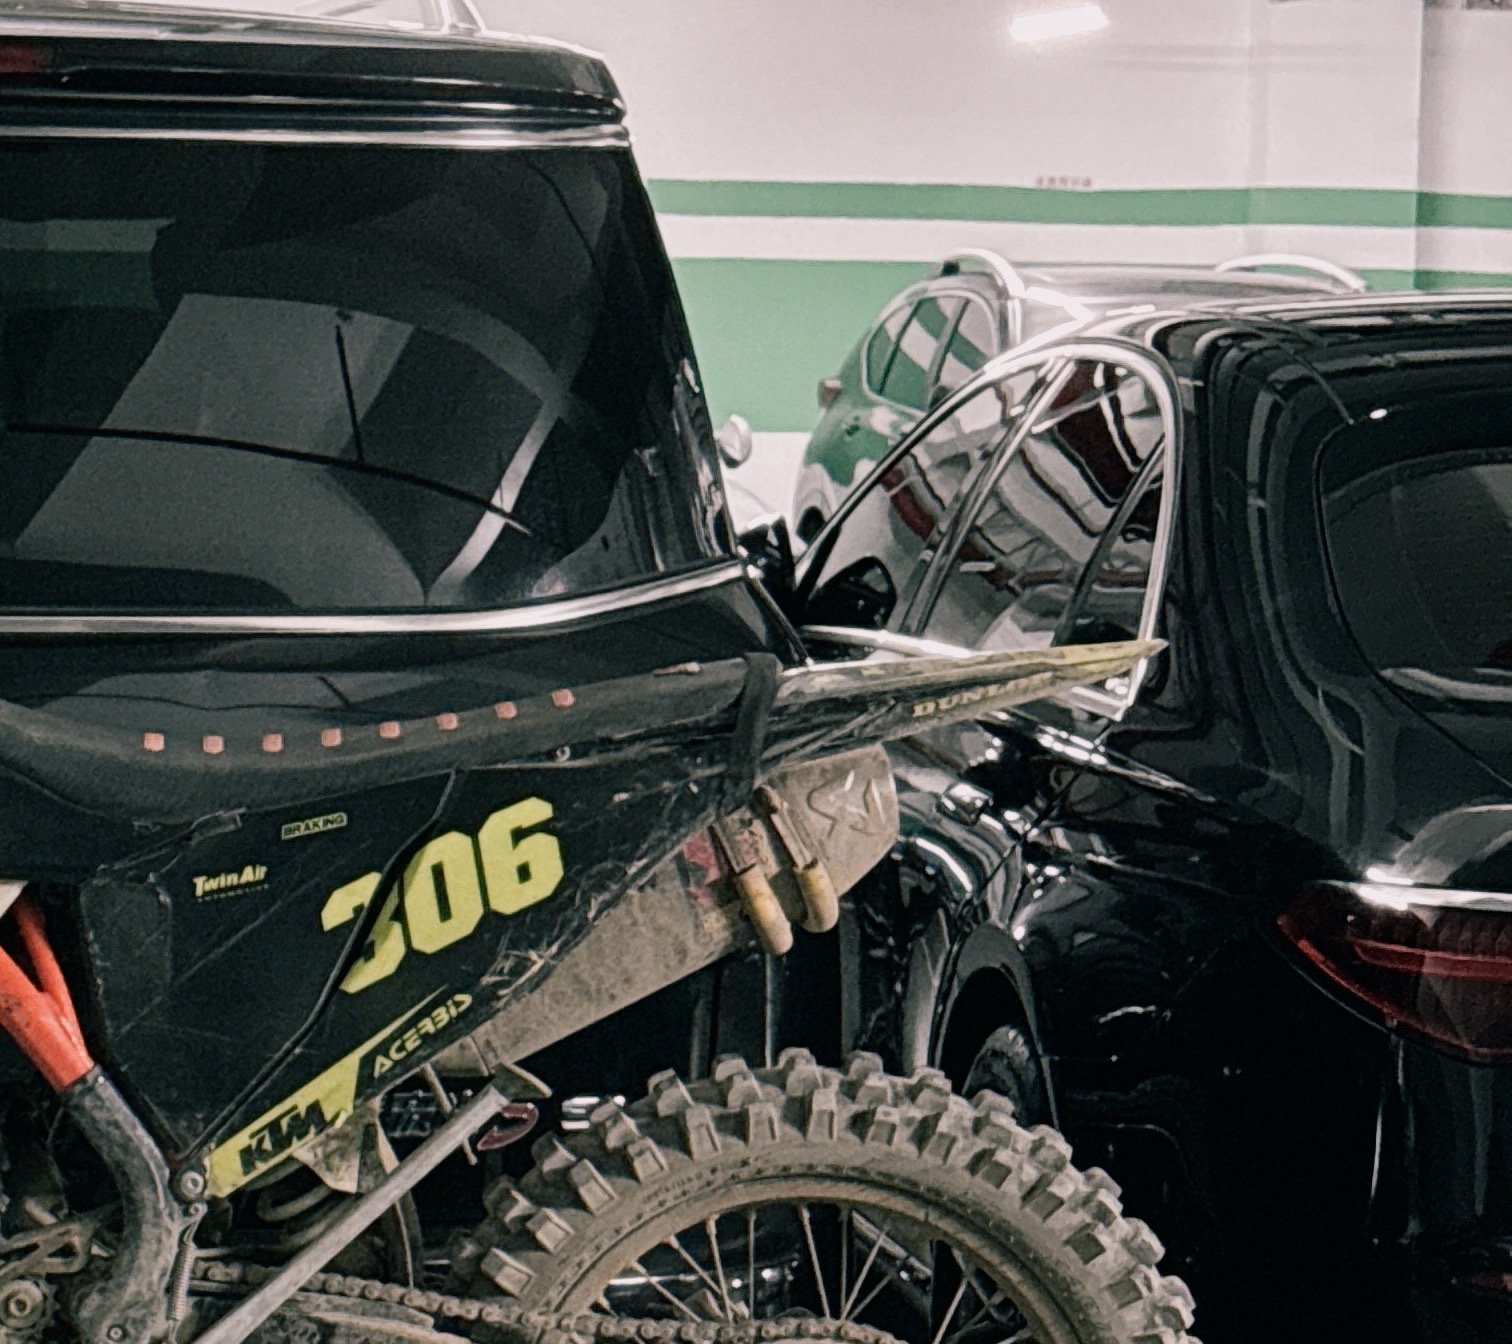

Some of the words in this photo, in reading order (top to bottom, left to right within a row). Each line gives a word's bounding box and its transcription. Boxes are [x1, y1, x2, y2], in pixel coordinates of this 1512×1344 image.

[321, 796, 565, 995] 306
[373, 992, 473, 1077] ACERBIS
[240, 1099, 335, 1175] KTM
